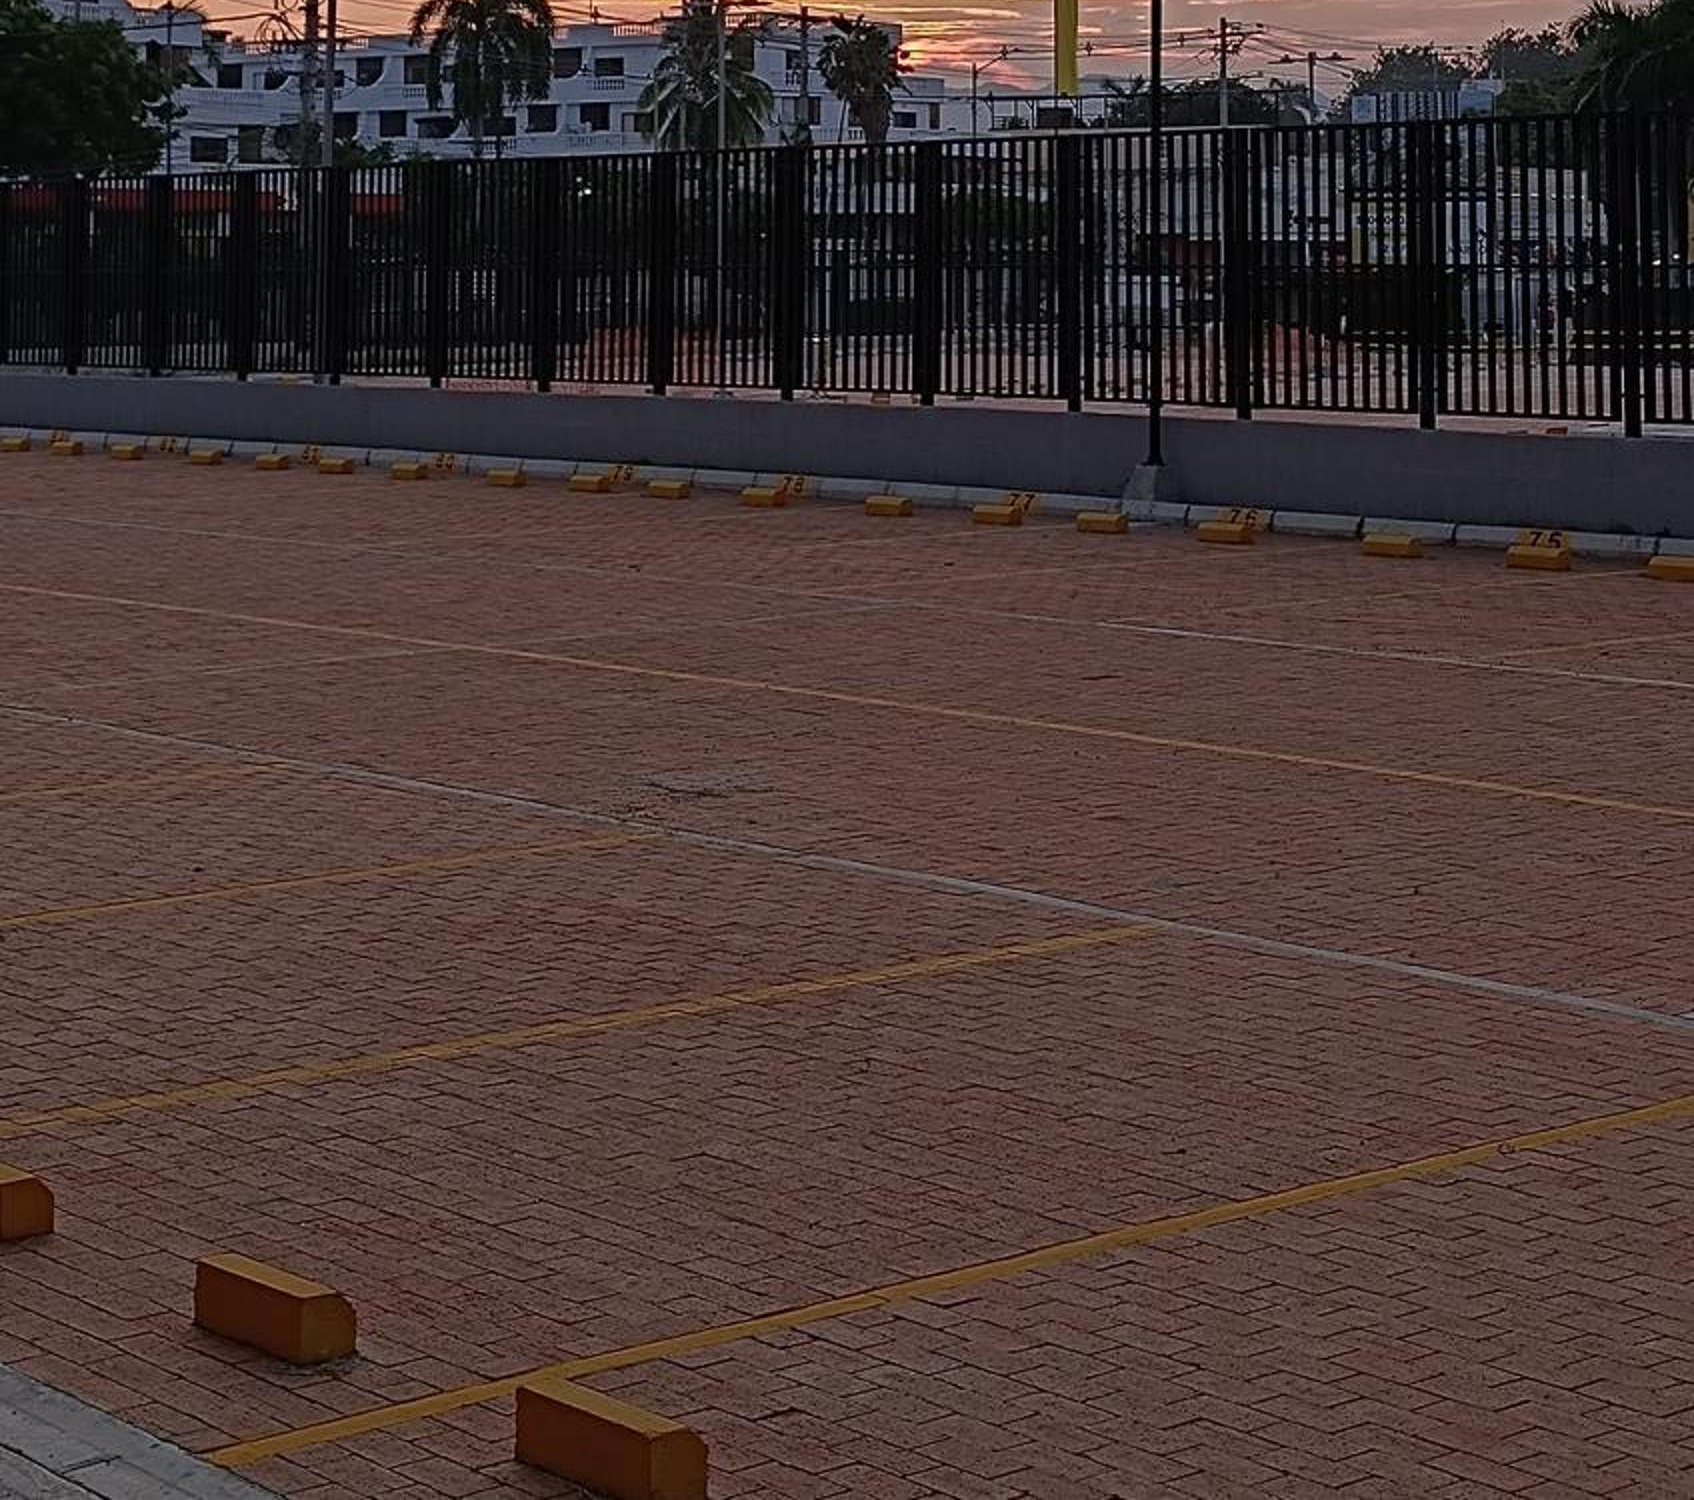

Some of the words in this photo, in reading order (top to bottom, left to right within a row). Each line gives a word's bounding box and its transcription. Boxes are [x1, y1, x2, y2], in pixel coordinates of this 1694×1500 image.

[1008, 493, 1035, 510] 77
[1230, 509, 1258, 527] 76
[1528, 531, 1563, 548] 75
